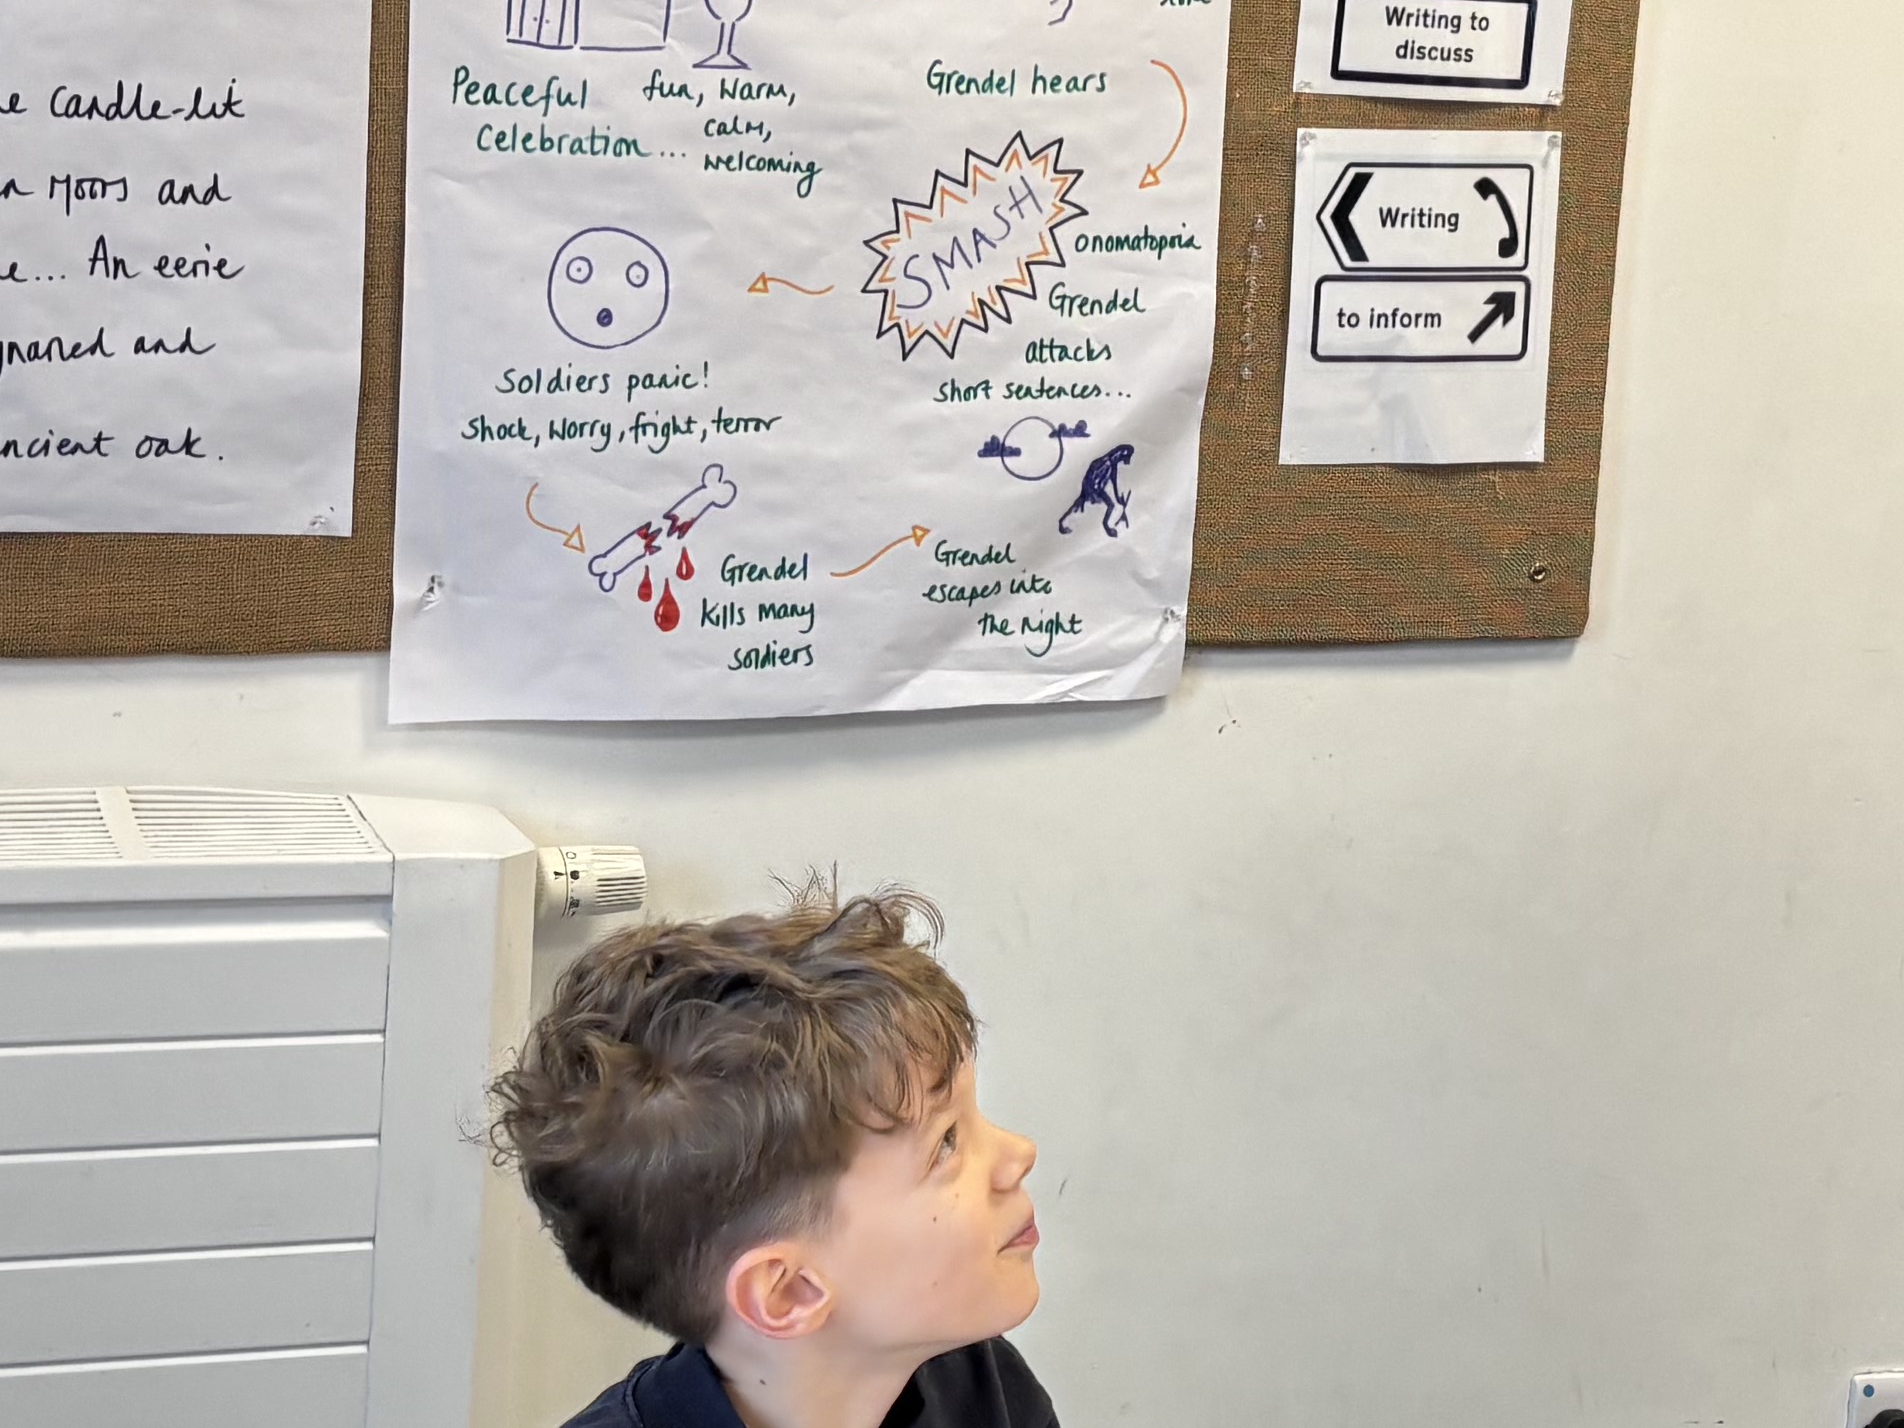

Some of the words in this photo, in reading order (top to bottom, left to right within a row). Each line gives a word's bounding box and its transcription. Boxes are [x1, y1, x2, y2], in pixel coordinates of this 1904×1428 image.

[1383, 4, 1463, 36] Writing
[1468, 10, 1491, 33] to
[1393, 38, 1475, 65] discuss
[451, 66, 589, 112] Peaceful
[925, 60, 1017, 98] Grendel
[1030, 63, 1108, 96] hears
[1377, 205, 1461, 235] Writing
[893, 173, 1048, 311] SMASH
[151, 242, 245, 281] eerie
[1047, 280, 1147, 319] Grendel
[1335, 306, 1362, 330] to
[1367, 306, 1443, 330] inform
[1023, 336, 1113, 365] attacks
[133, 426, 225, 462] oak.
[719, 551, 810, 588] Grendel
[933, 538, 1018, 568] Grendel
[921, 579, 1003, 609] escapes
